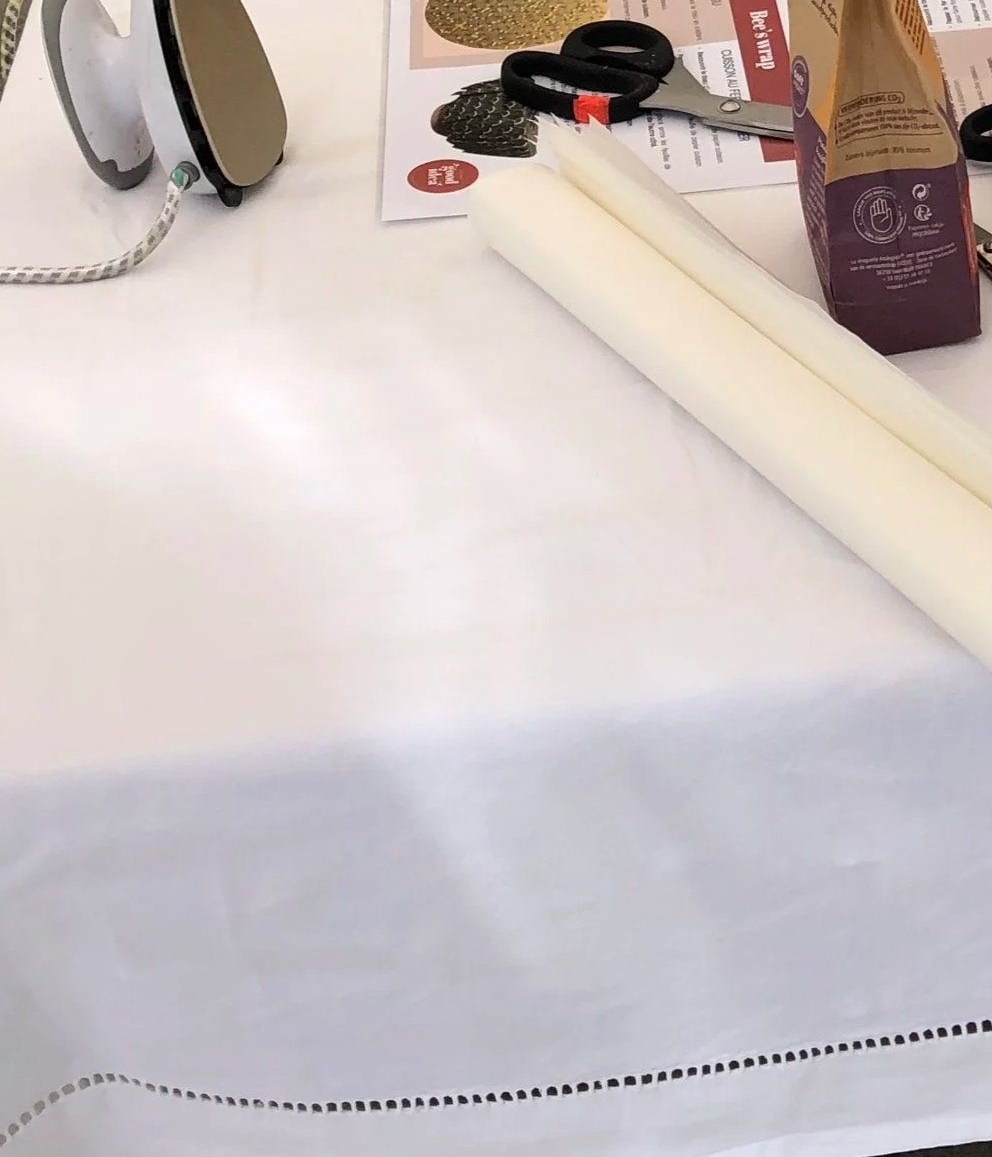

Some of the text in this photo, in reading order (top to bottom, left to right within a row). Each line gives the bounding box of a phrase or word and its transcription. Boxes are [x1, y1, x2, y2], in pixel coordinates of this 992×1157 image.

[721, 49, 736, 78] CUISSON
[755, 39, 776, 70] wrap
[427, 168, 443, 186] idea
[438, 165, 460, 185] good
